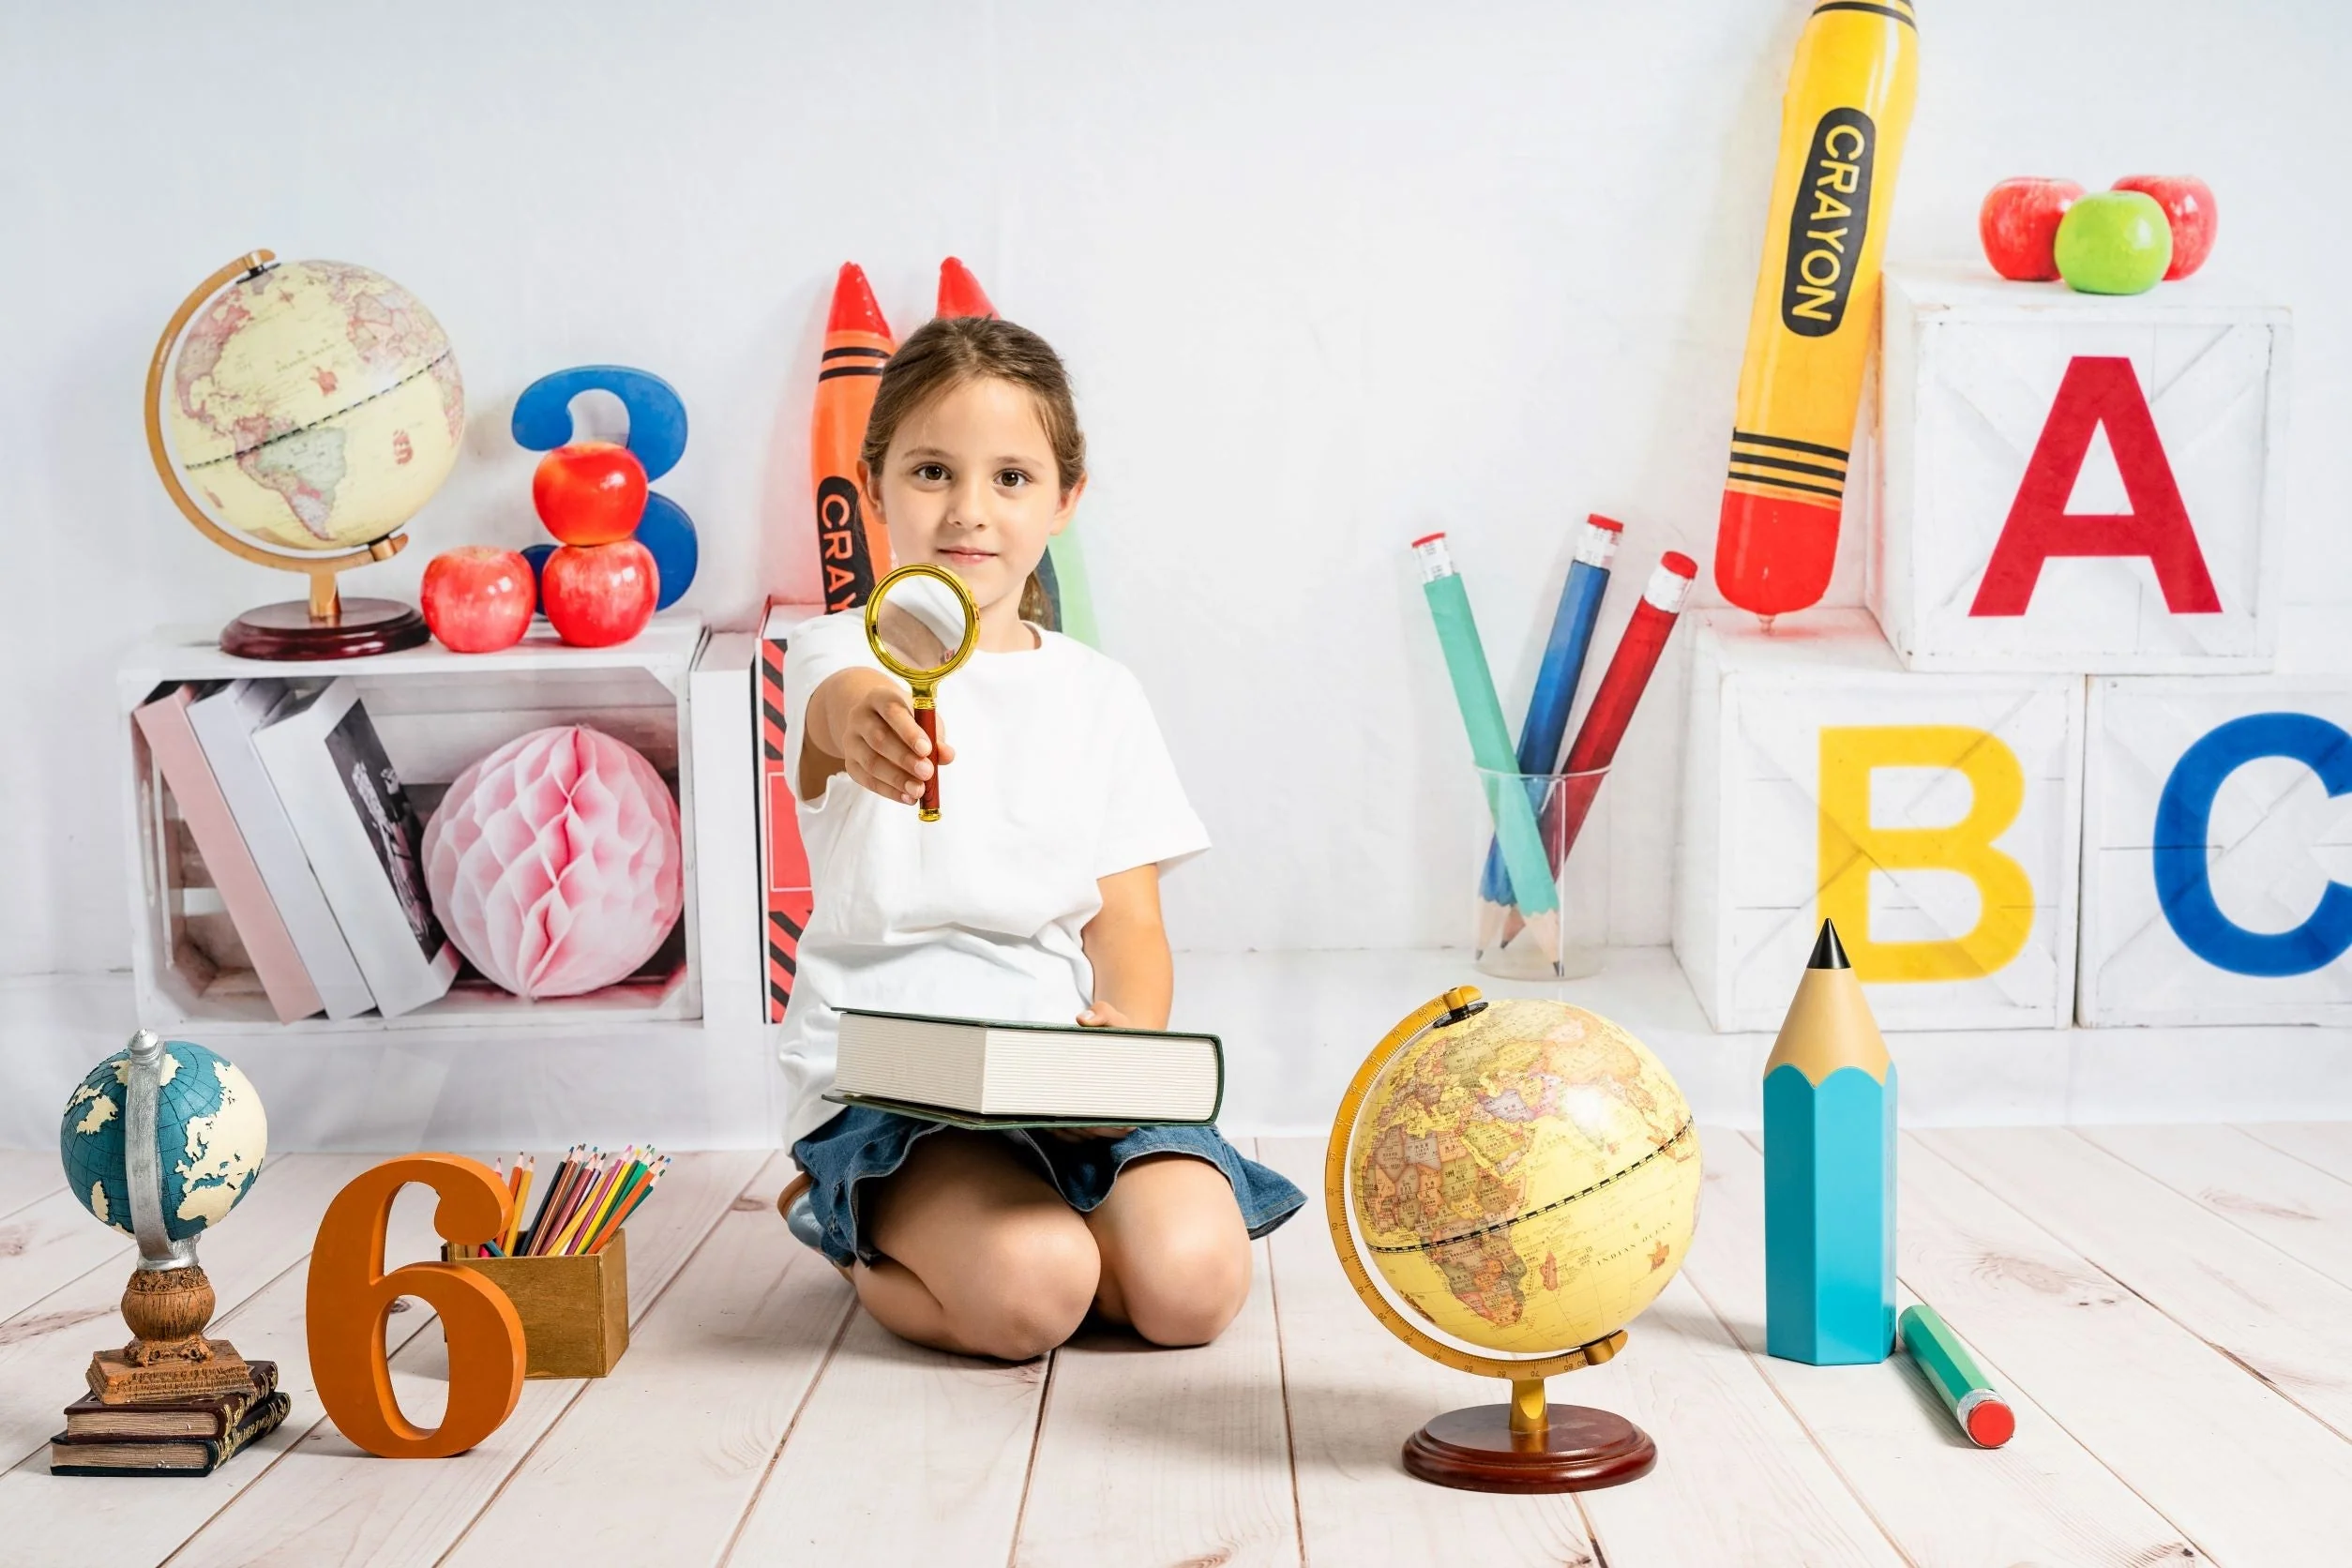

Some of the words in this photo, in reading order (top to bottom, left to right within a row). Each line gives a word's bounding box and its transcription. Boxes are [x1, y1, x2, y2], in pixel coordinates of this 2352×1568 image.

[1791, 124, 1865, 323] CRAYON
[1968, 355, 2224, 617] A
[1817, 724, 2036, 985] B
[2153, 711, 2352, 978] C
[306, 1153, 527, 1459] 6
[1596, 1243, 1636, 1266] INDIAN
